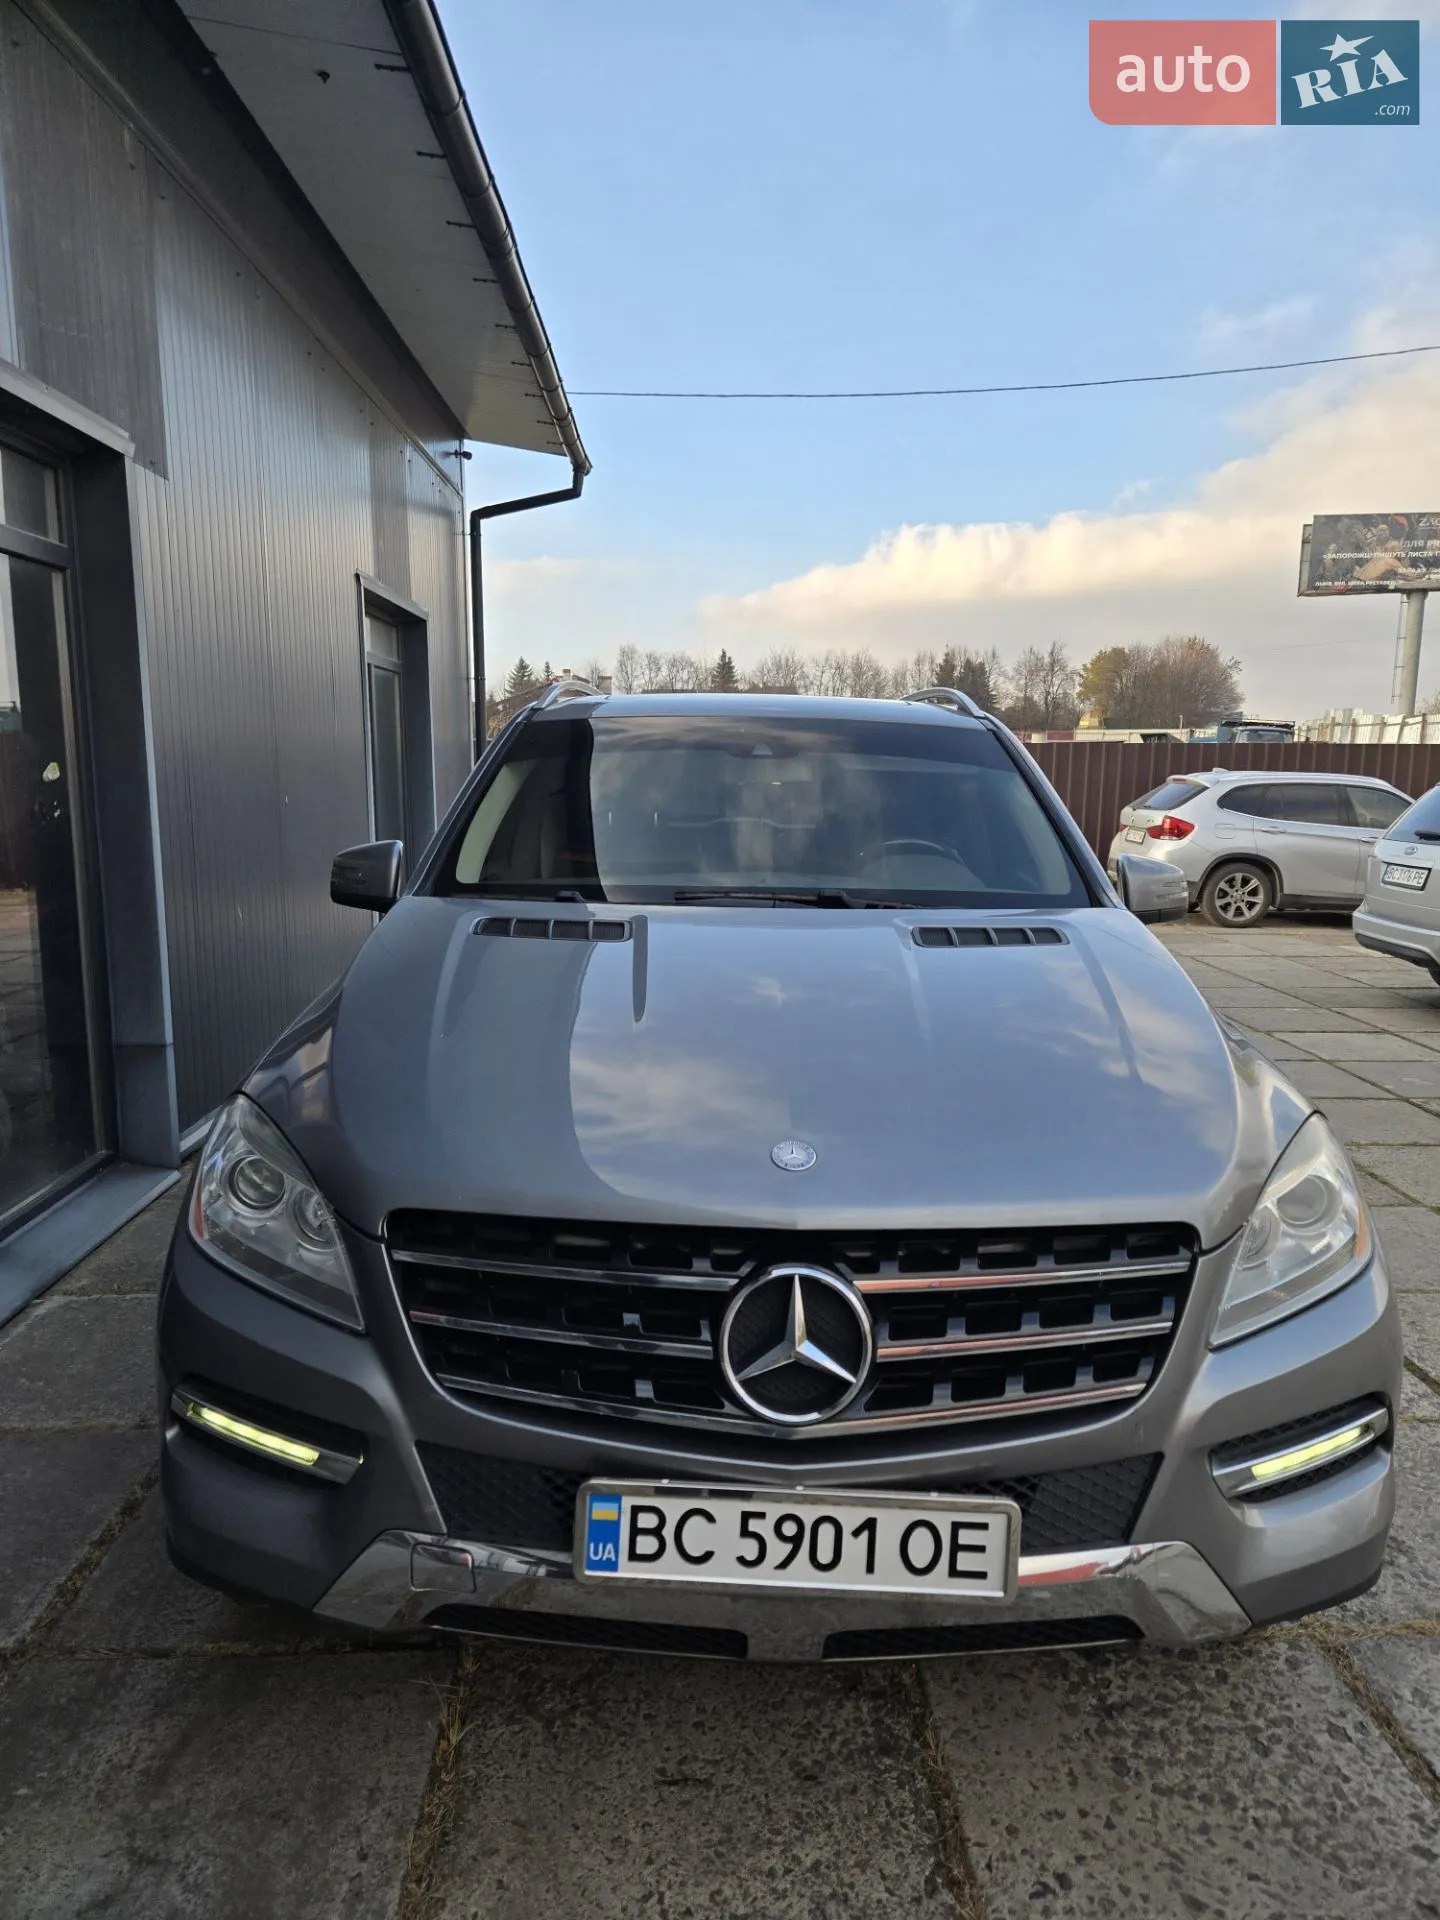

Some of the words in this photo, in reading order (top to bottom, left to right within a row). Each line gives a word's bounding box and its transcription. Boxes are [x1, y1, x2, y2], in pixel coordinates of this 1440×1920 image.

[589, 1541, 616, 1562] UA
[627, 1504, 717, 1567] BC
[735, 1510, 878, 1575] 5901
[899, 1519, 990, 1580] OE
